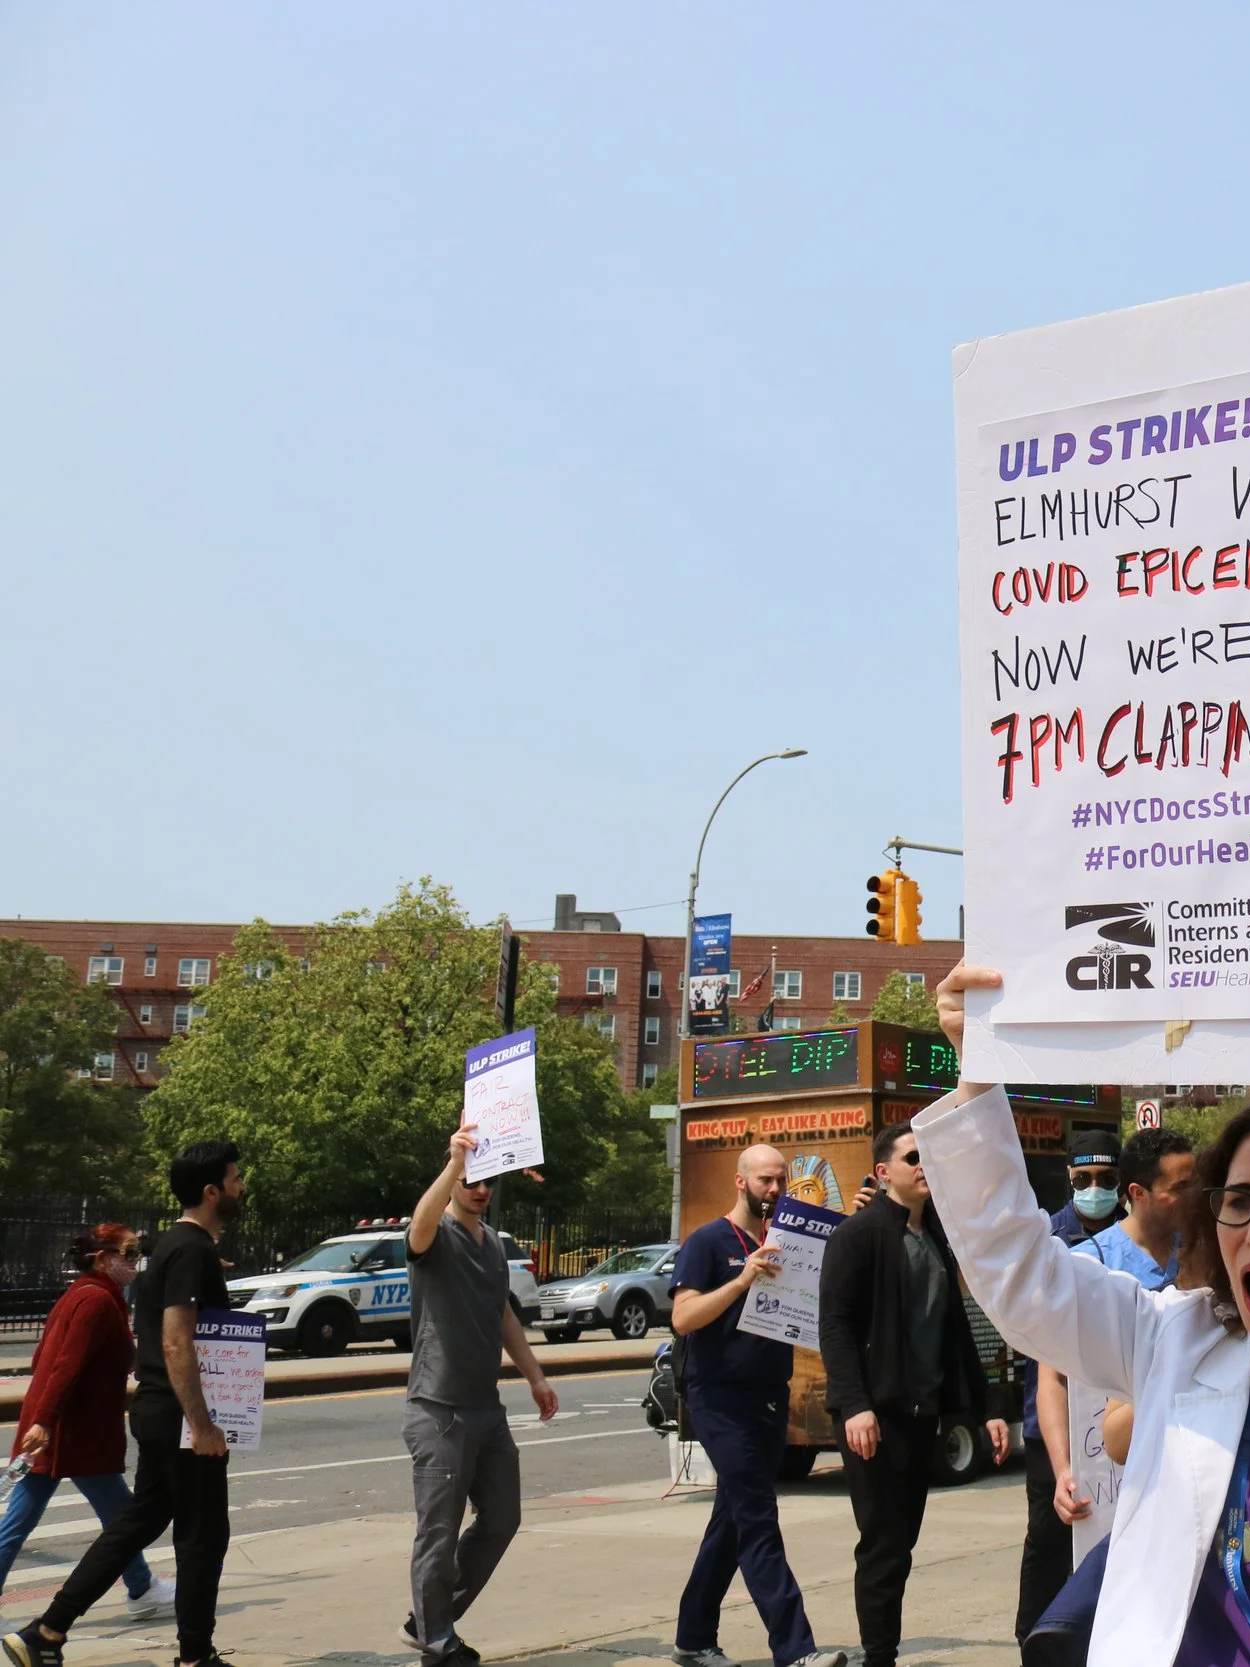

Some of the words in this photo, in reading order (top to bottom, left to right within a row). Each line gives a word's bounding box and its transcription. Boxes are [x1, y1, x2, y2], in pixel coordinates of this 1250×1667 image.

[998, 432, 1077, 482] ULP
[996, 473, 1192, 546] ELMHURST
[992, 561, 1089, 616] COVID
[992, 635, 1087, 701] NOW
[990, 706, 1085, 805] 7PM
[1167, 921, 1241, 943] Interns
[469, 1058, 488, 1074] ULP
[489, 1040, 531, 1066] STRIKE!
[471, 1075, 509, 1105] FAIR
[472, 1092, 529, 1124] CONTRACT
[490, 1107, 530, 1134] NOW!!!
[688, 1119, 719, 1140] KING
[720, 1119, 746, 1137] TUT
[762, 1115, 786, 1133] EAT
[787, 1113, 816, 1130] LIKE
[818, 1112, 829, 1127] A
[831, 1109, 865, 1126] KING
[778, 1212, 806, 1230] ULP
[767, 1254, 787, 1267] PAY
[371, 1284, 411, 1305] NYP
[196, 1324, 219, 1335] ULP
[220, 1324, 263, 1337] STRIKE!
[237, 1345, 250, 1358] for
